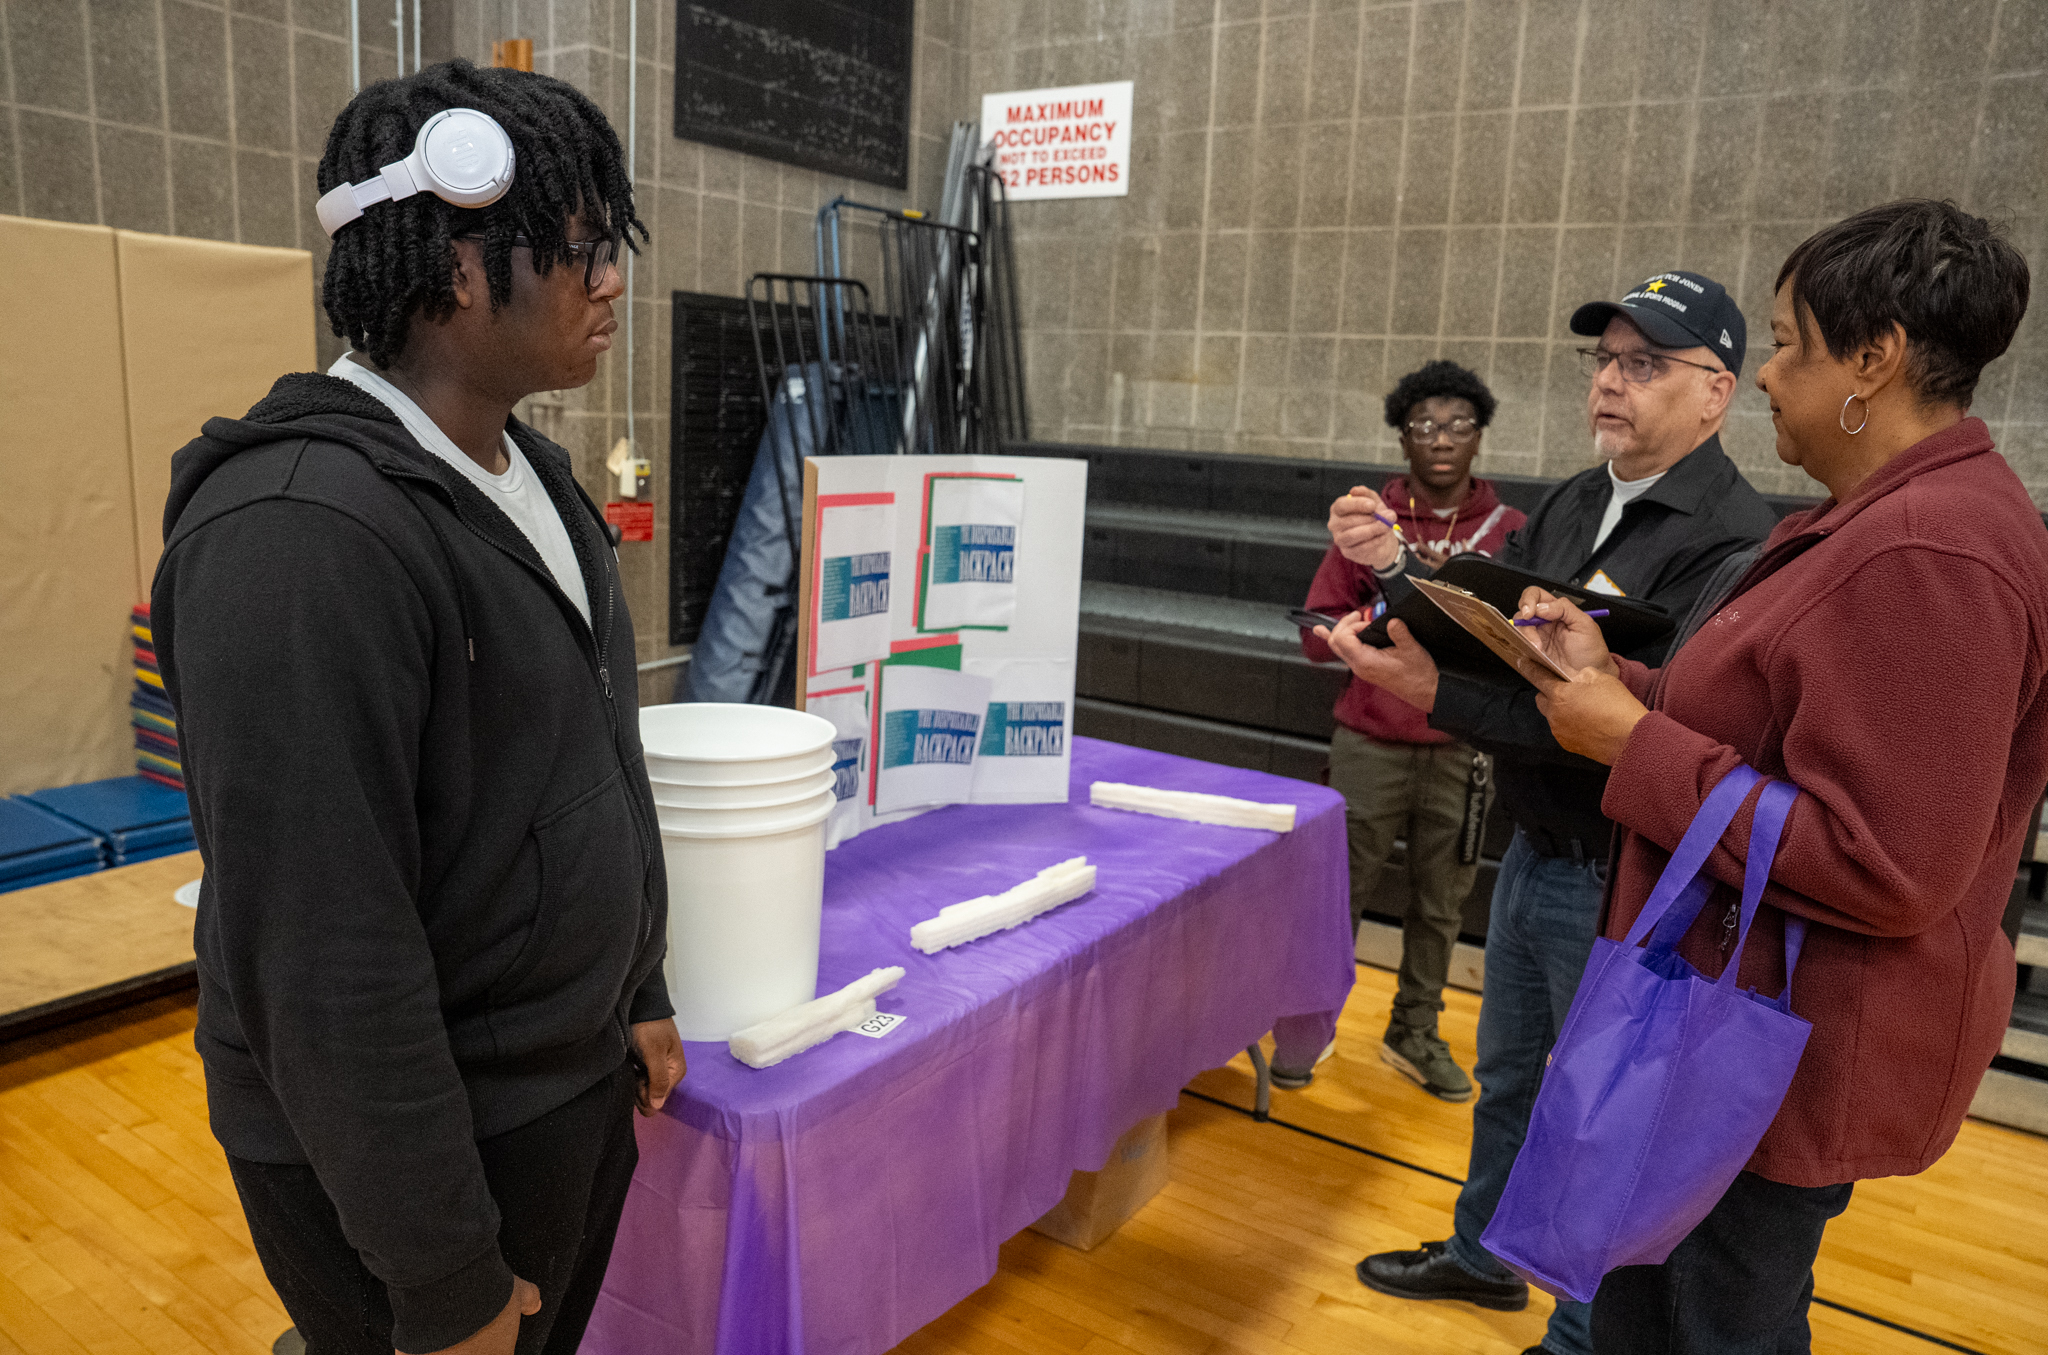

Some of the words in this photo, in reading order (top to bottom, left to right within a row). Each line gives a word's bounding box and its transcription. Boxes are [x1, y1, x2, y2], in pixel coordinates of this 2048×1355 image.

[1006, 98, 1104, 124] MAXIMUM
[994, 122, 1117, 148] OCCUPANCY
[1000, 152, 1026, 166] NOT
[1032, 150, 1050, 163] TO
[1053, 147, 1107, 162] EXCEED
[1026, 163, 1119, 186] PERSONS
[1679, 278, 1705, 294] JONES
[1662, 296, 1688, 313] PROGRAM
[959, 550, 1014, 582] BACKPACK
[849, 579, 889, 616] BACKPACK
[913, 733, 976, 763] BACKPACK
[1005, 725, 1064, 755] BACKPACK
[861, 1015, 894, 1033] G23
